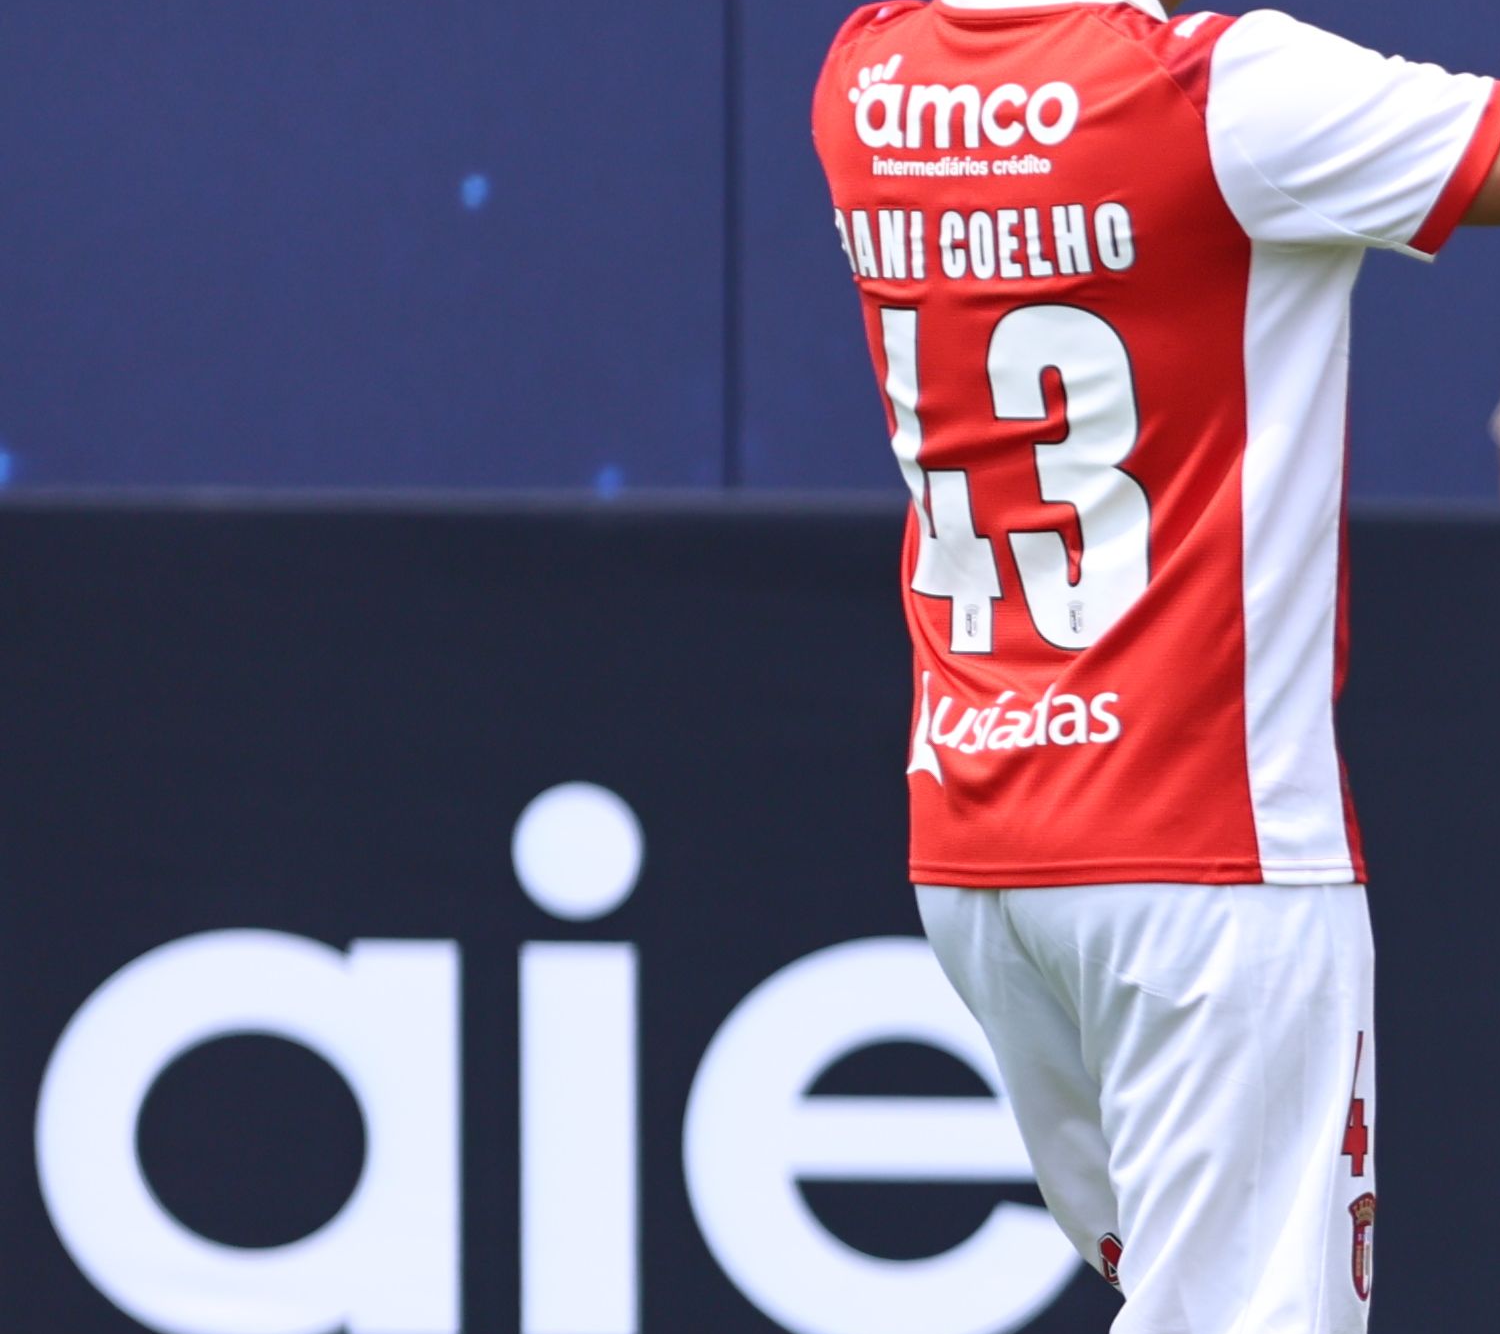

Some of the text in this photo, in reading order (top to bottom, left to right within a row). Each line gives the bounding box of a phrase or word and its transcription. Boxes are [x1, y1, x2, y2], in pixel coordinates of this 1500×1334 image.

[854, 80, 1080, 149] amco
[872, 154, 1053, 177] intermediários crédito
[939, 202, 1136, 280] COELHO
[879, 303, 1152, 655] 43
